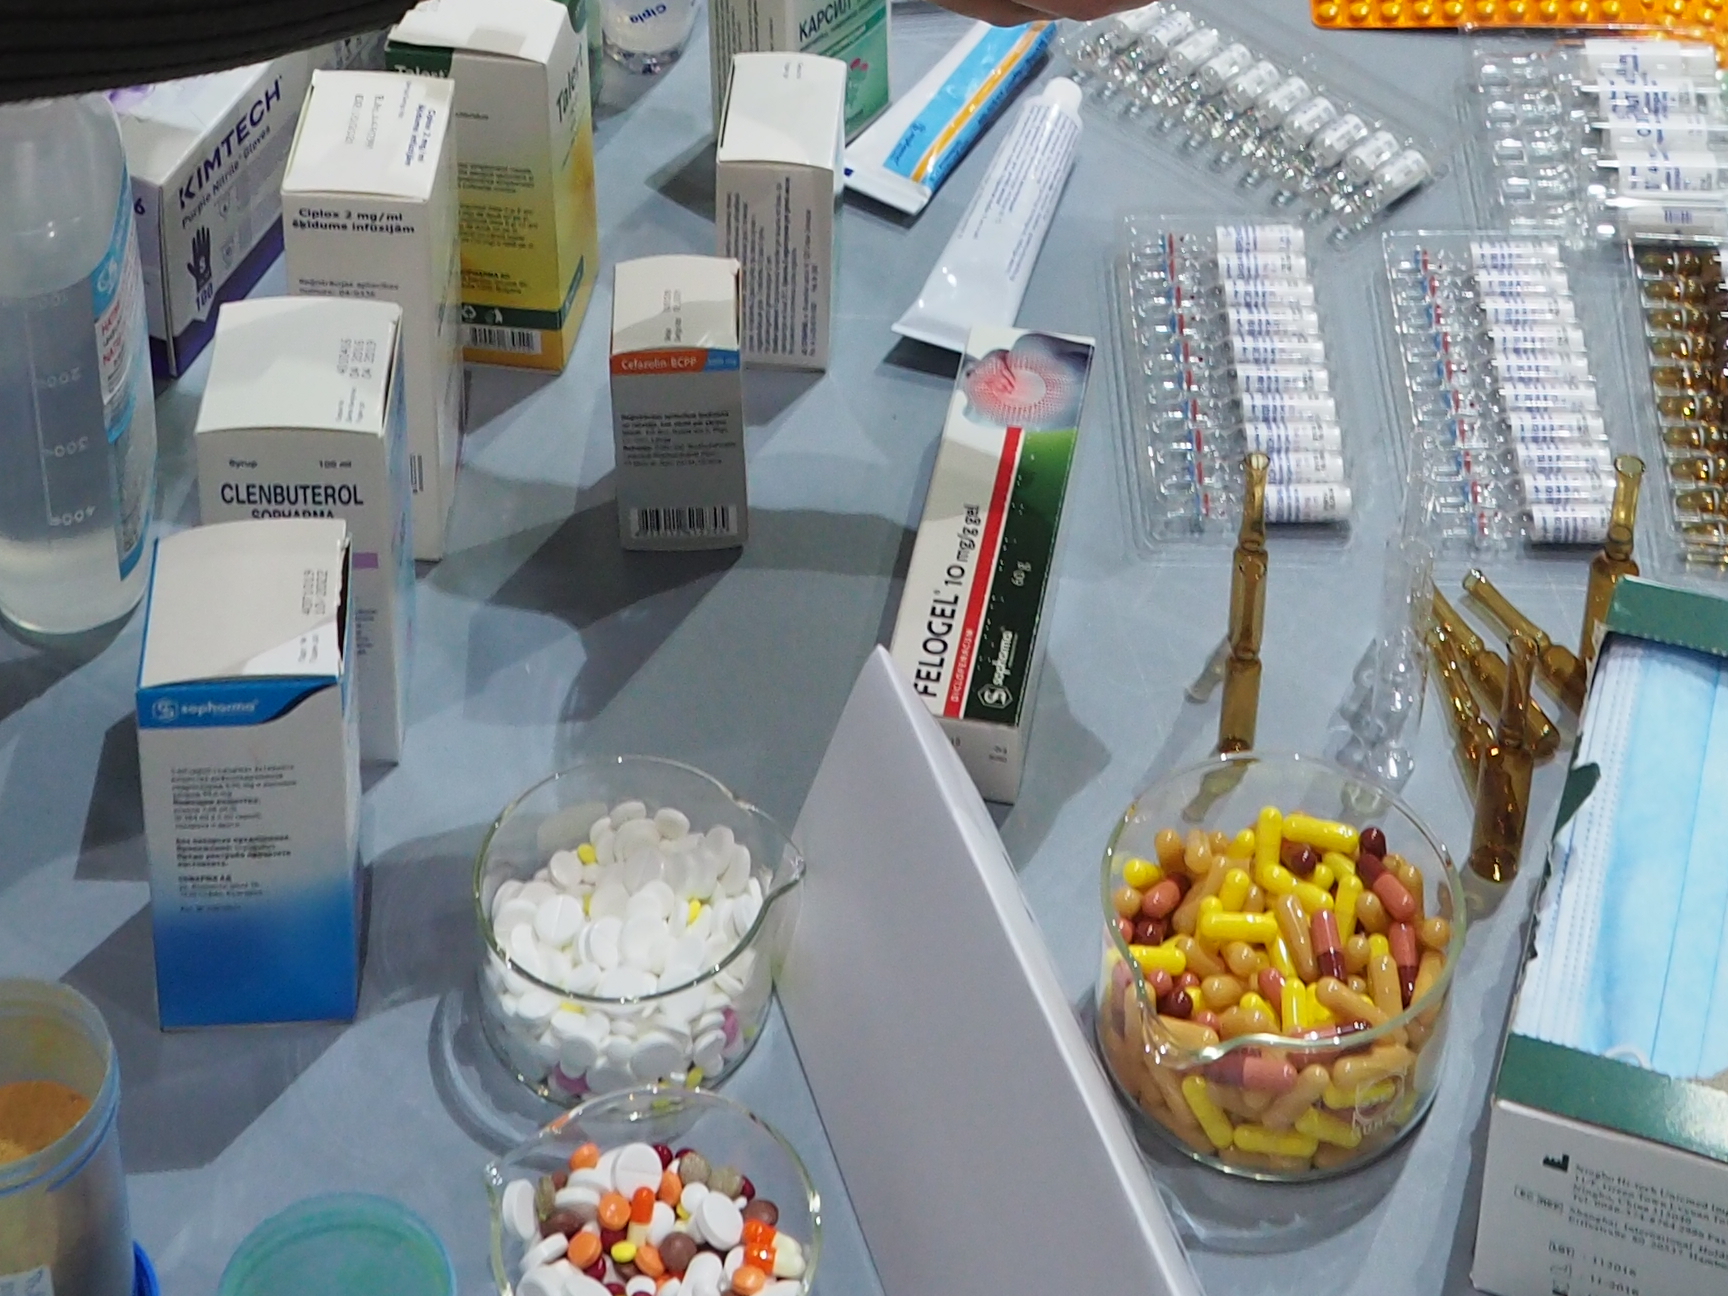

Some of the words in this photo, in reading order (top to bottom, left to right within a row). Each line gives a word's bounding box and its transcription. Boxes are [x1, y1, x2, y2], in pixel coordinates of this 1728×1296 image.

[629, 4, 667, 25] Cipla
[179, 76, 282, 209] KIMTECH
[298, 208, 340, 222] Ciplox
[357, 211, 404, 224] mg/ml
[195, 287, 214, 311] 100
[220, 483, 364, 507] CLENBUTEROL
[914, 594, 959, 698] FELOGEL
[944, 564, 965, 587] 10
[180, 701, 256, 717] sopharma
